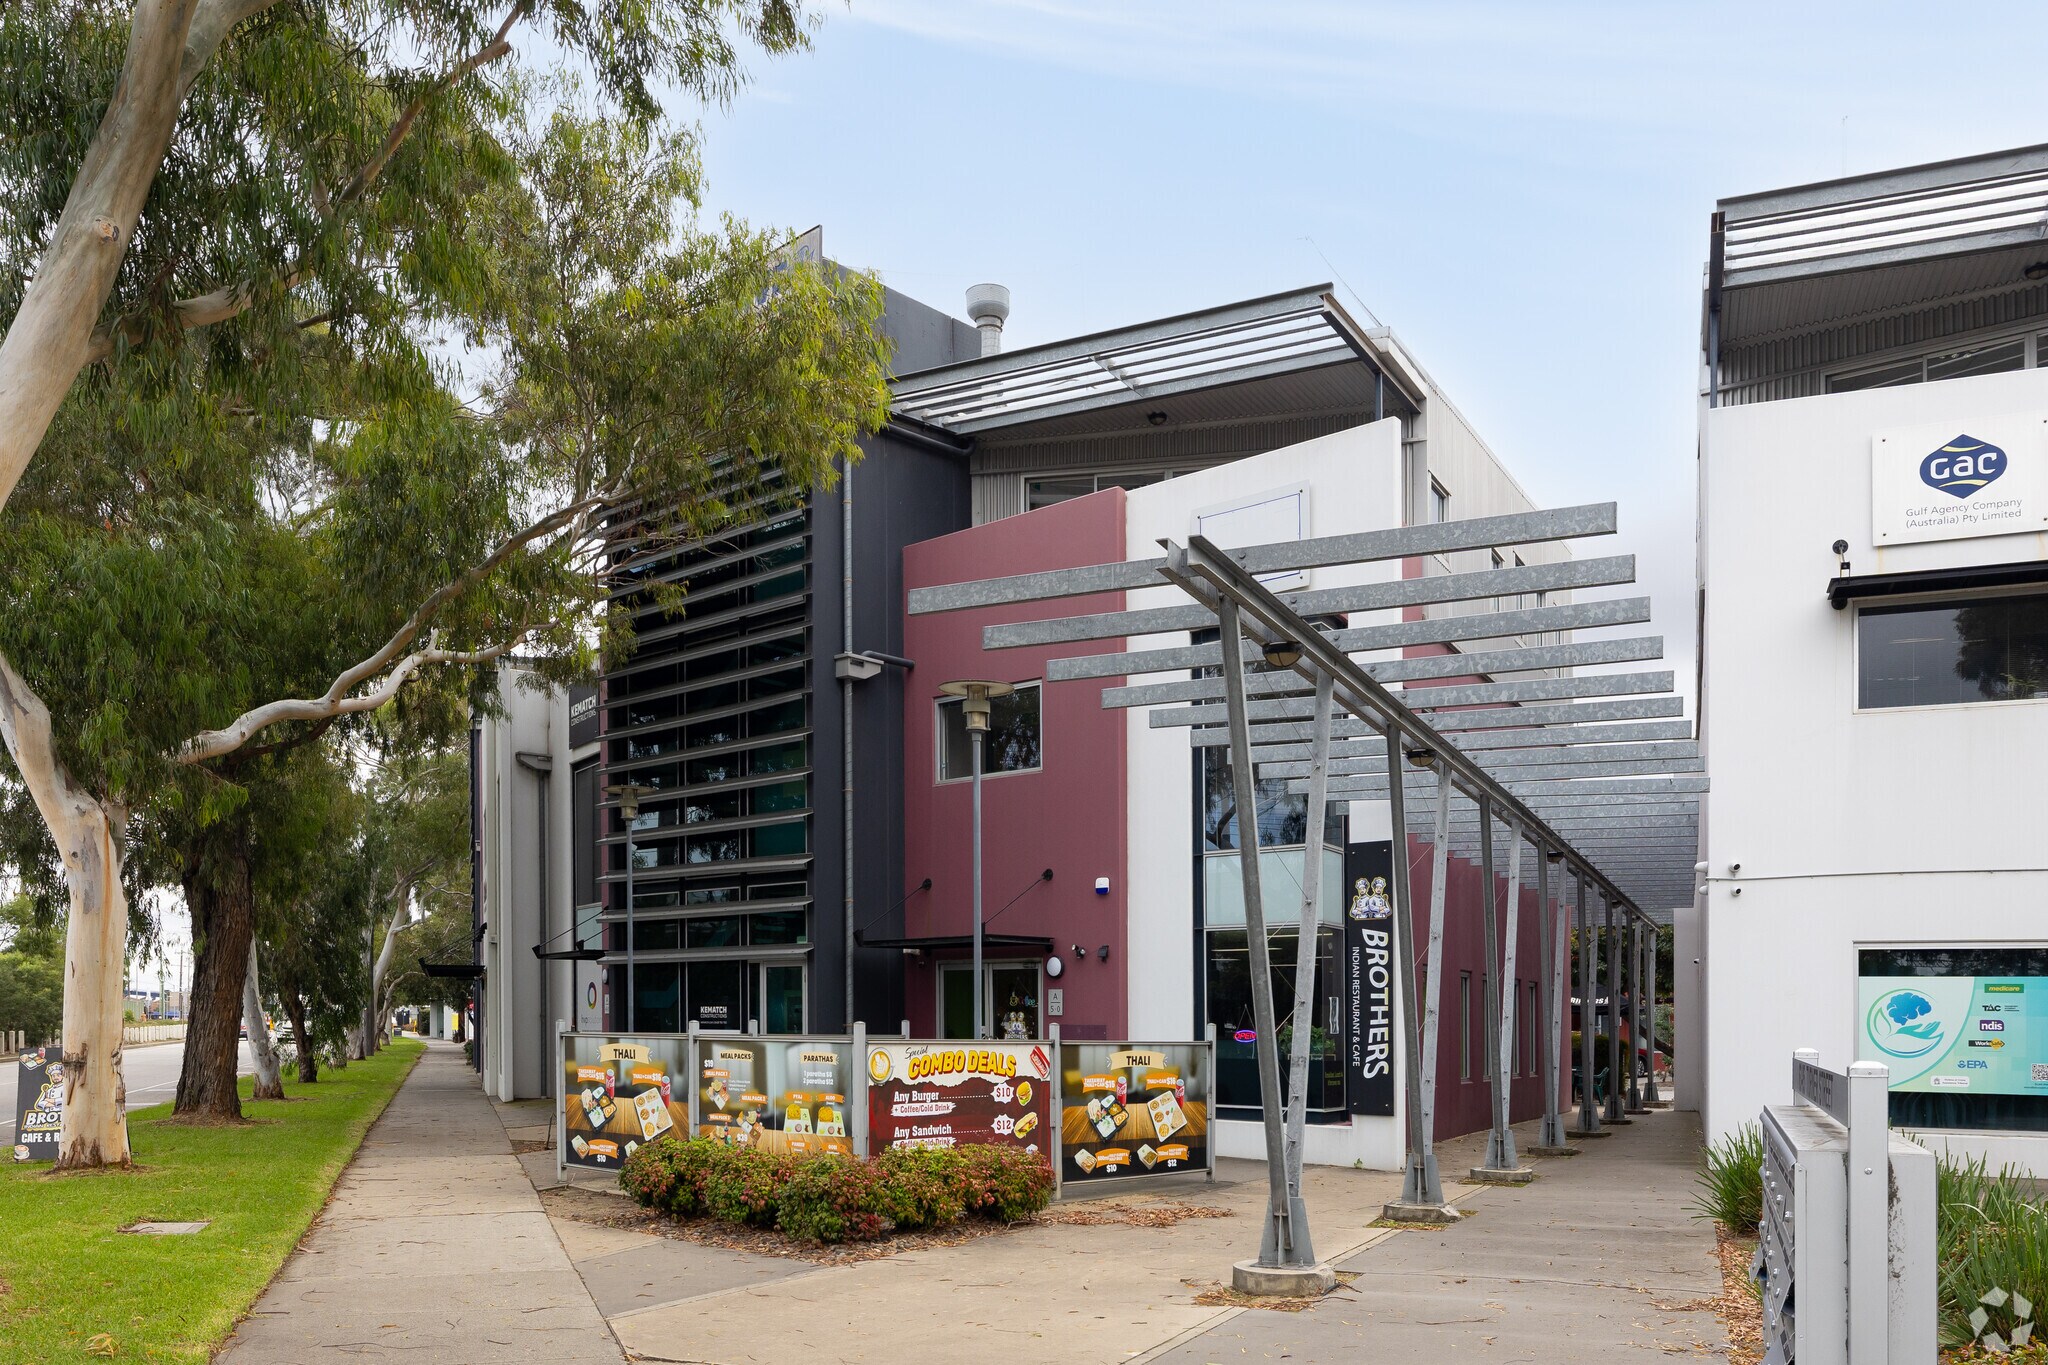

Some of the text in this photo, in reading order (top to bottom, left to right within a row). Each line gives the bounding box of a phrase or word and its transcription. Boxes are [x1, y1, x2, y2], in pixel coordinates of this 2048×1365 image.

[1905, 499, 2022, 517] Gulf Agency Company
[1906, 509, 2021, 528] (Australia) Pty Limited
[570, 694, 597, 718] KEMATCH
[1352, 946, 1360, 977] INDIAN
[1352, 979, 1360, 1035] RESTAURANT
[1361, 928, 1389, 1079] BROTHERS
[1982, 1004, 2001, 1012] TAC
[1981, 1021, 2002, 1030] ndis
[1234, 1032, 1256, 1040] OPEN
[613, 1048, 636, 1059] THALI
[803, 1055, 834, 1063] PARATHAS
[905, 1045, 928, 1060] Special
[1352, 1044, 1360, 1067] CAFE
[908, 1050, 966, 1080] COMBO
[967, 1050, 1017, 1078] DEALS
[1126, 1056, 1150, 1066] THALI
[1967, 1060, 1988, 1069] EPA
[893, 1088, 1011, 1103] Any Burger $10
[900, 1104, 934, 1114] Coffee/Cold
[935, 1104, 950, 1112] Drink
[26, 1112, 62, 1125] BROT
[893, 1120, 1011, 1139] Any Sandwich $12
[21, 1132, 43, 1143] CAFE
[45, 1132, 52, 1143] &
[1106, 1163, 1117, 1173] $10
[1167, 1158, 1177, 1167] $12
